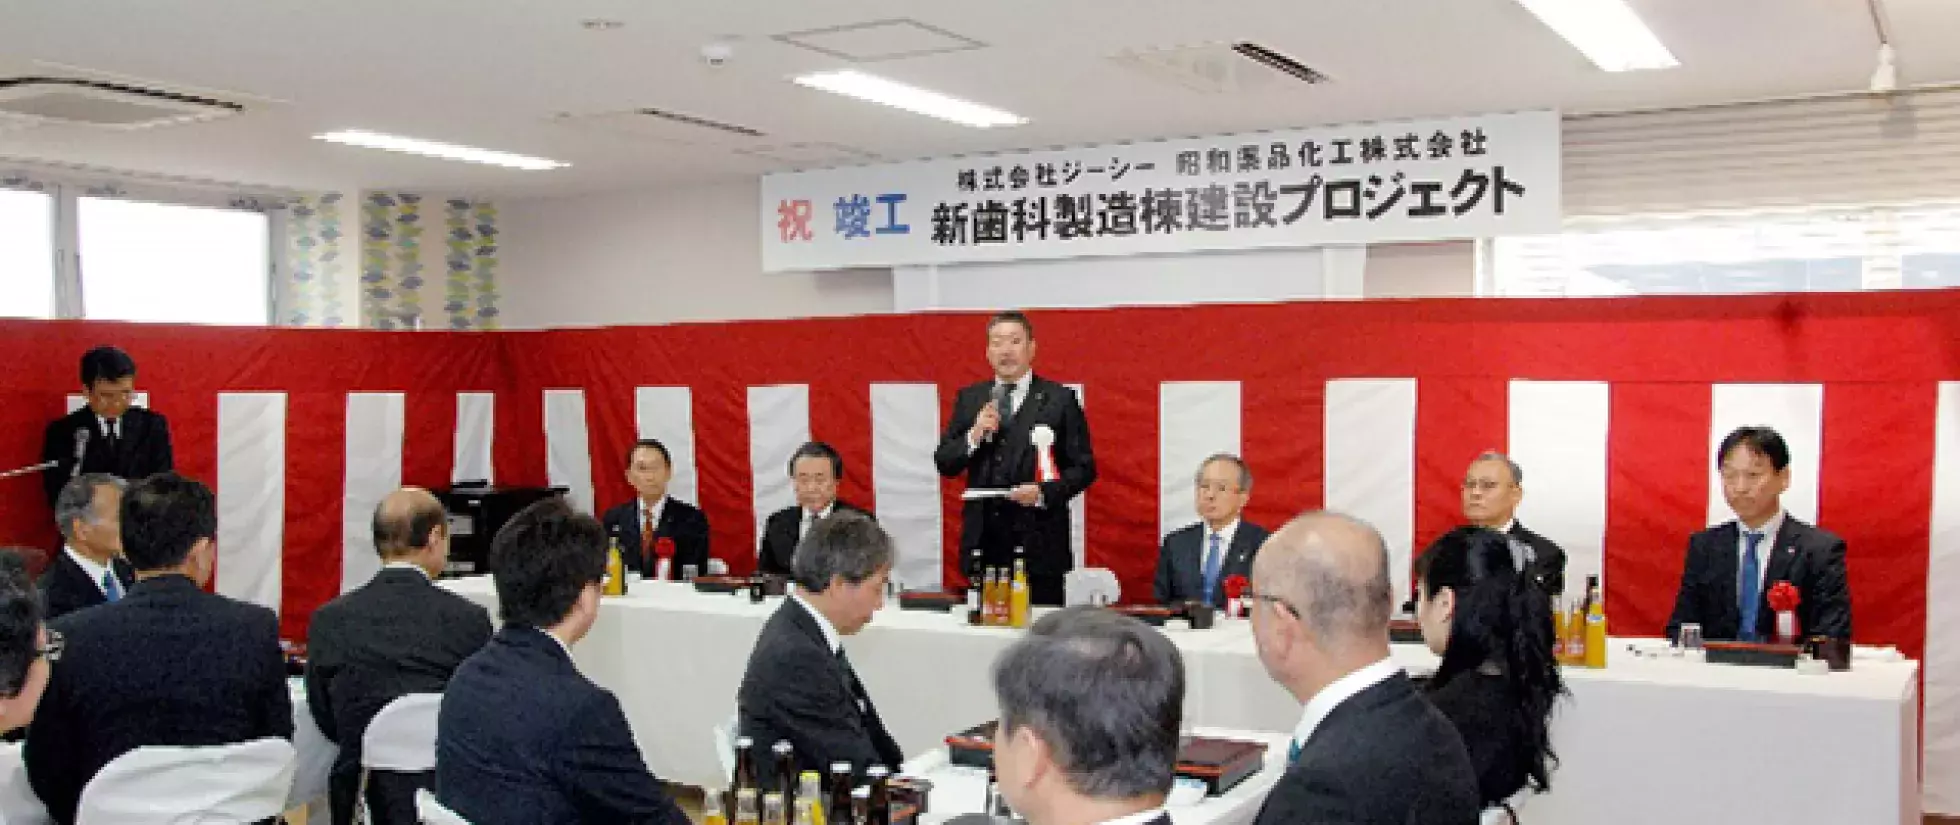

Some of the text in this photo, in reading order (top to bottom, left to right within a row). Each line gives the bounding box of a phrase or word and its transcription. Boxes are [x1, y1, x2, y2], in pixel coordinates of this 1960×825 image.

[956, 156, 1156, 192] 株式会社ジーシー
[777, 165, 1526, 246] 祝 竣工 新歯科製造棟建設プロジェクト
